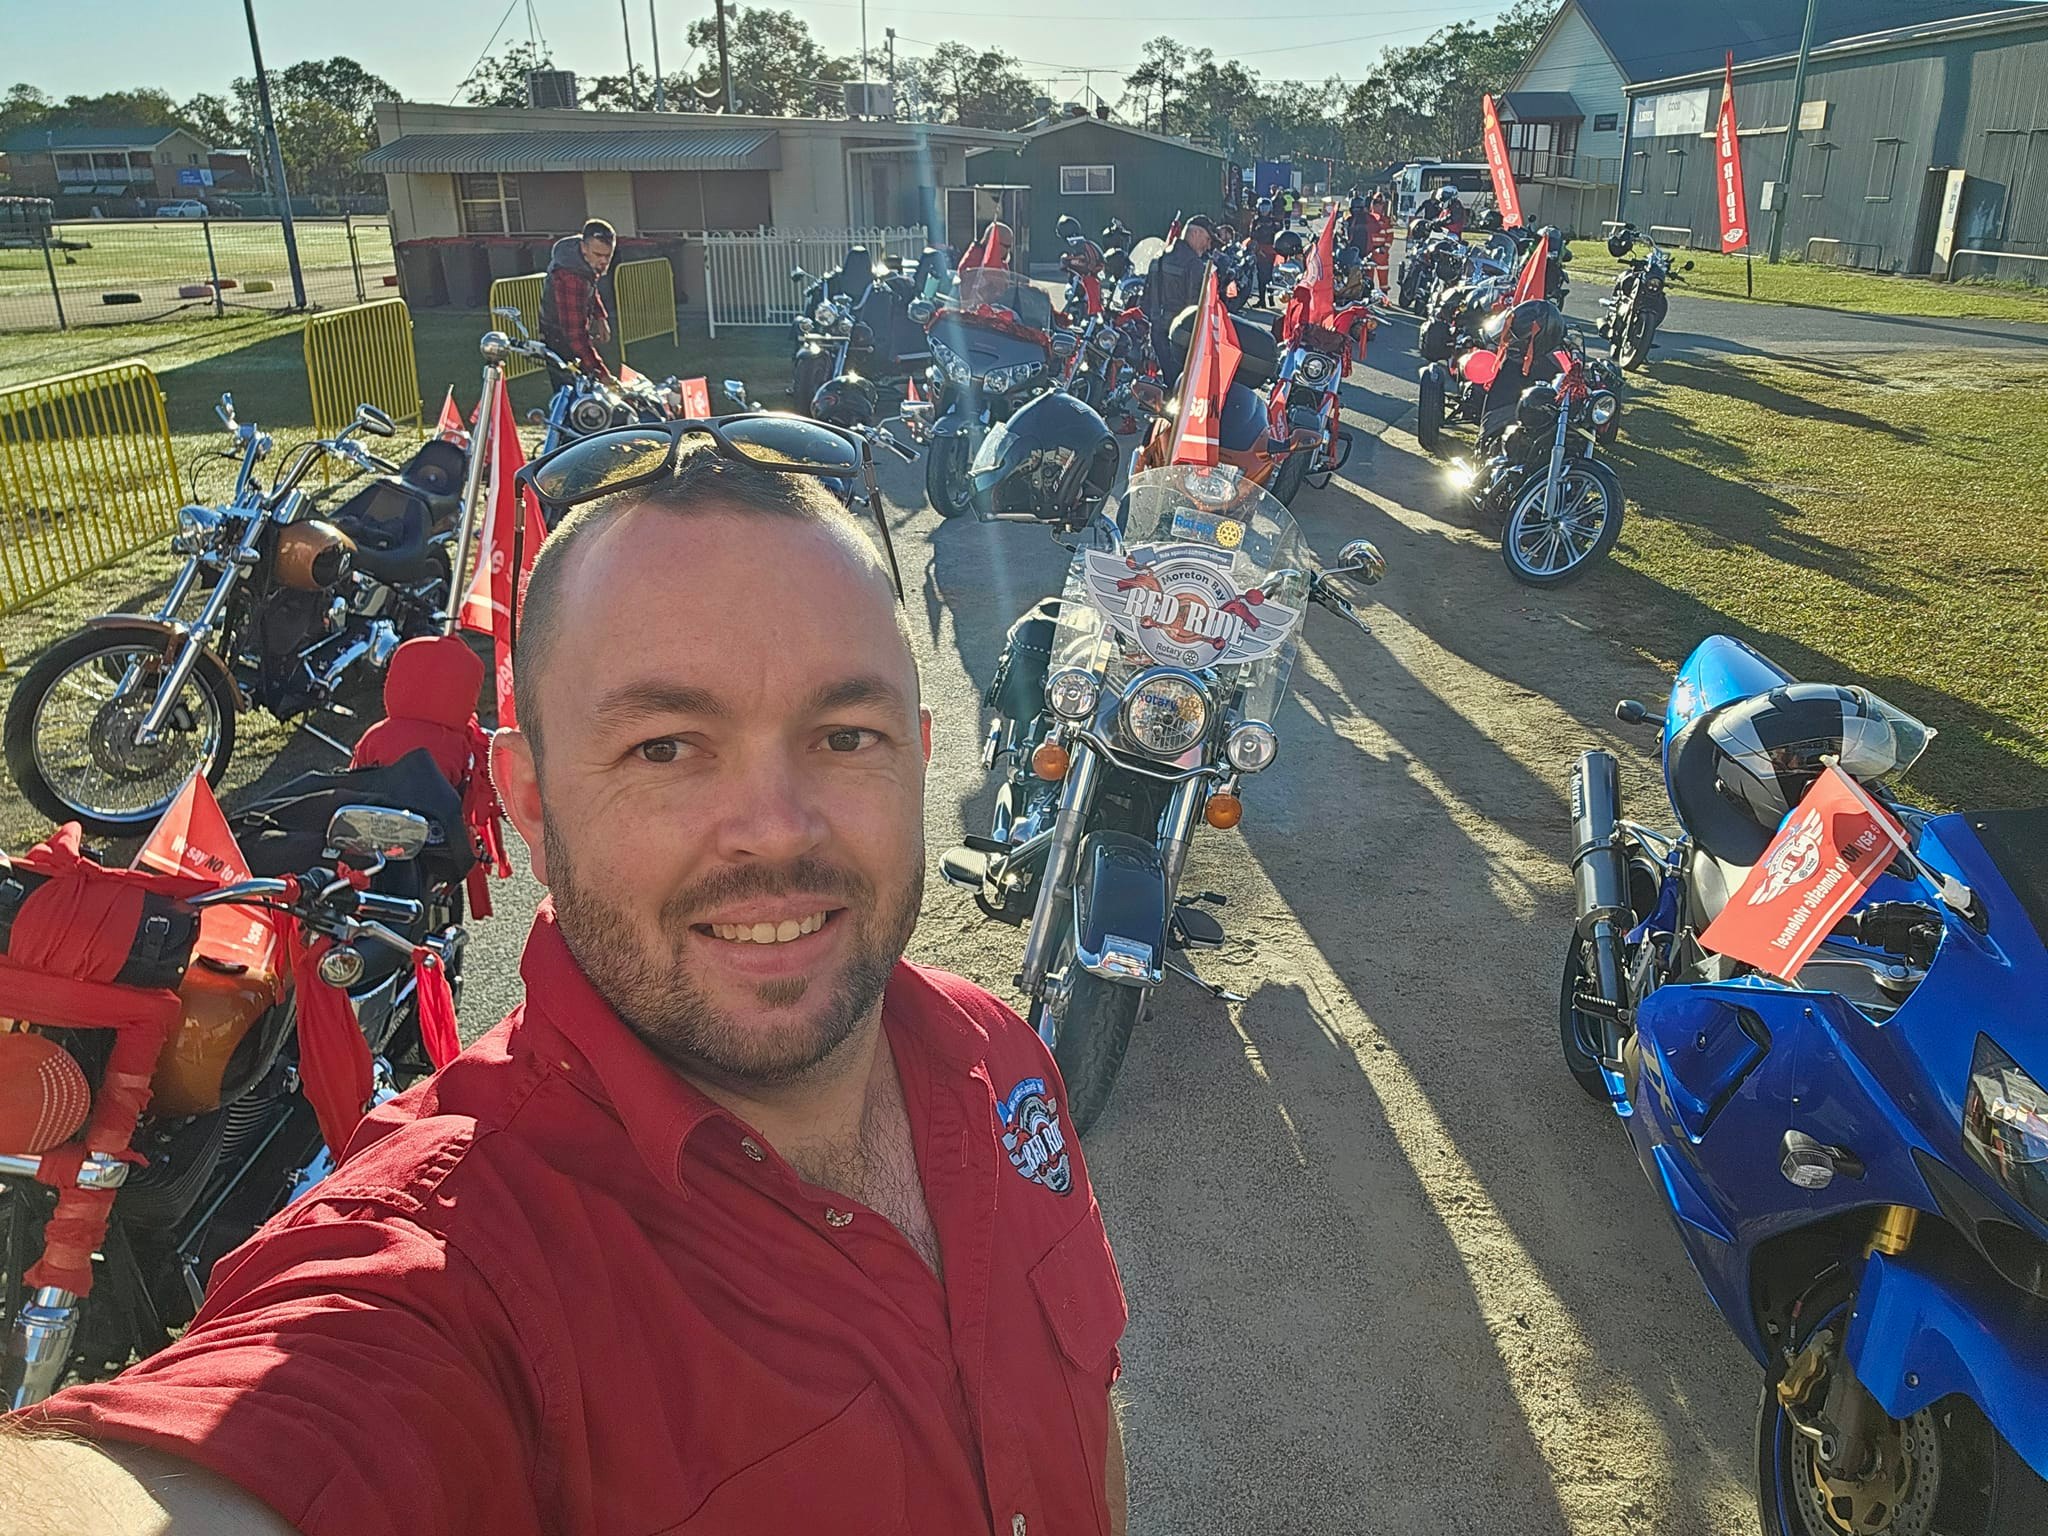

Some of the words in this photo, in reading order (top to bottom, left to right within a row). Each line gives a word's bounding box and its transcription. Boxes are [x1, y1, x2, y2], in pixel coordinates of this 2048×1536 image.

[1189, 396, 1209, 424] say
[1161, 571, 1210, 586] Moreton
[1211, 581, 1226, 601] Bay
[1124, 587, 1179, 625] RED
[1183, 601, 1246, 647] RIDE
[1155, 642, 1183, 658] Rotary
[1137, 690, 1178, 712] Rotary
[186, 846, 209, 867] say
[204, 855, 225, 873] NO
[220, 864, 235, 882] to
